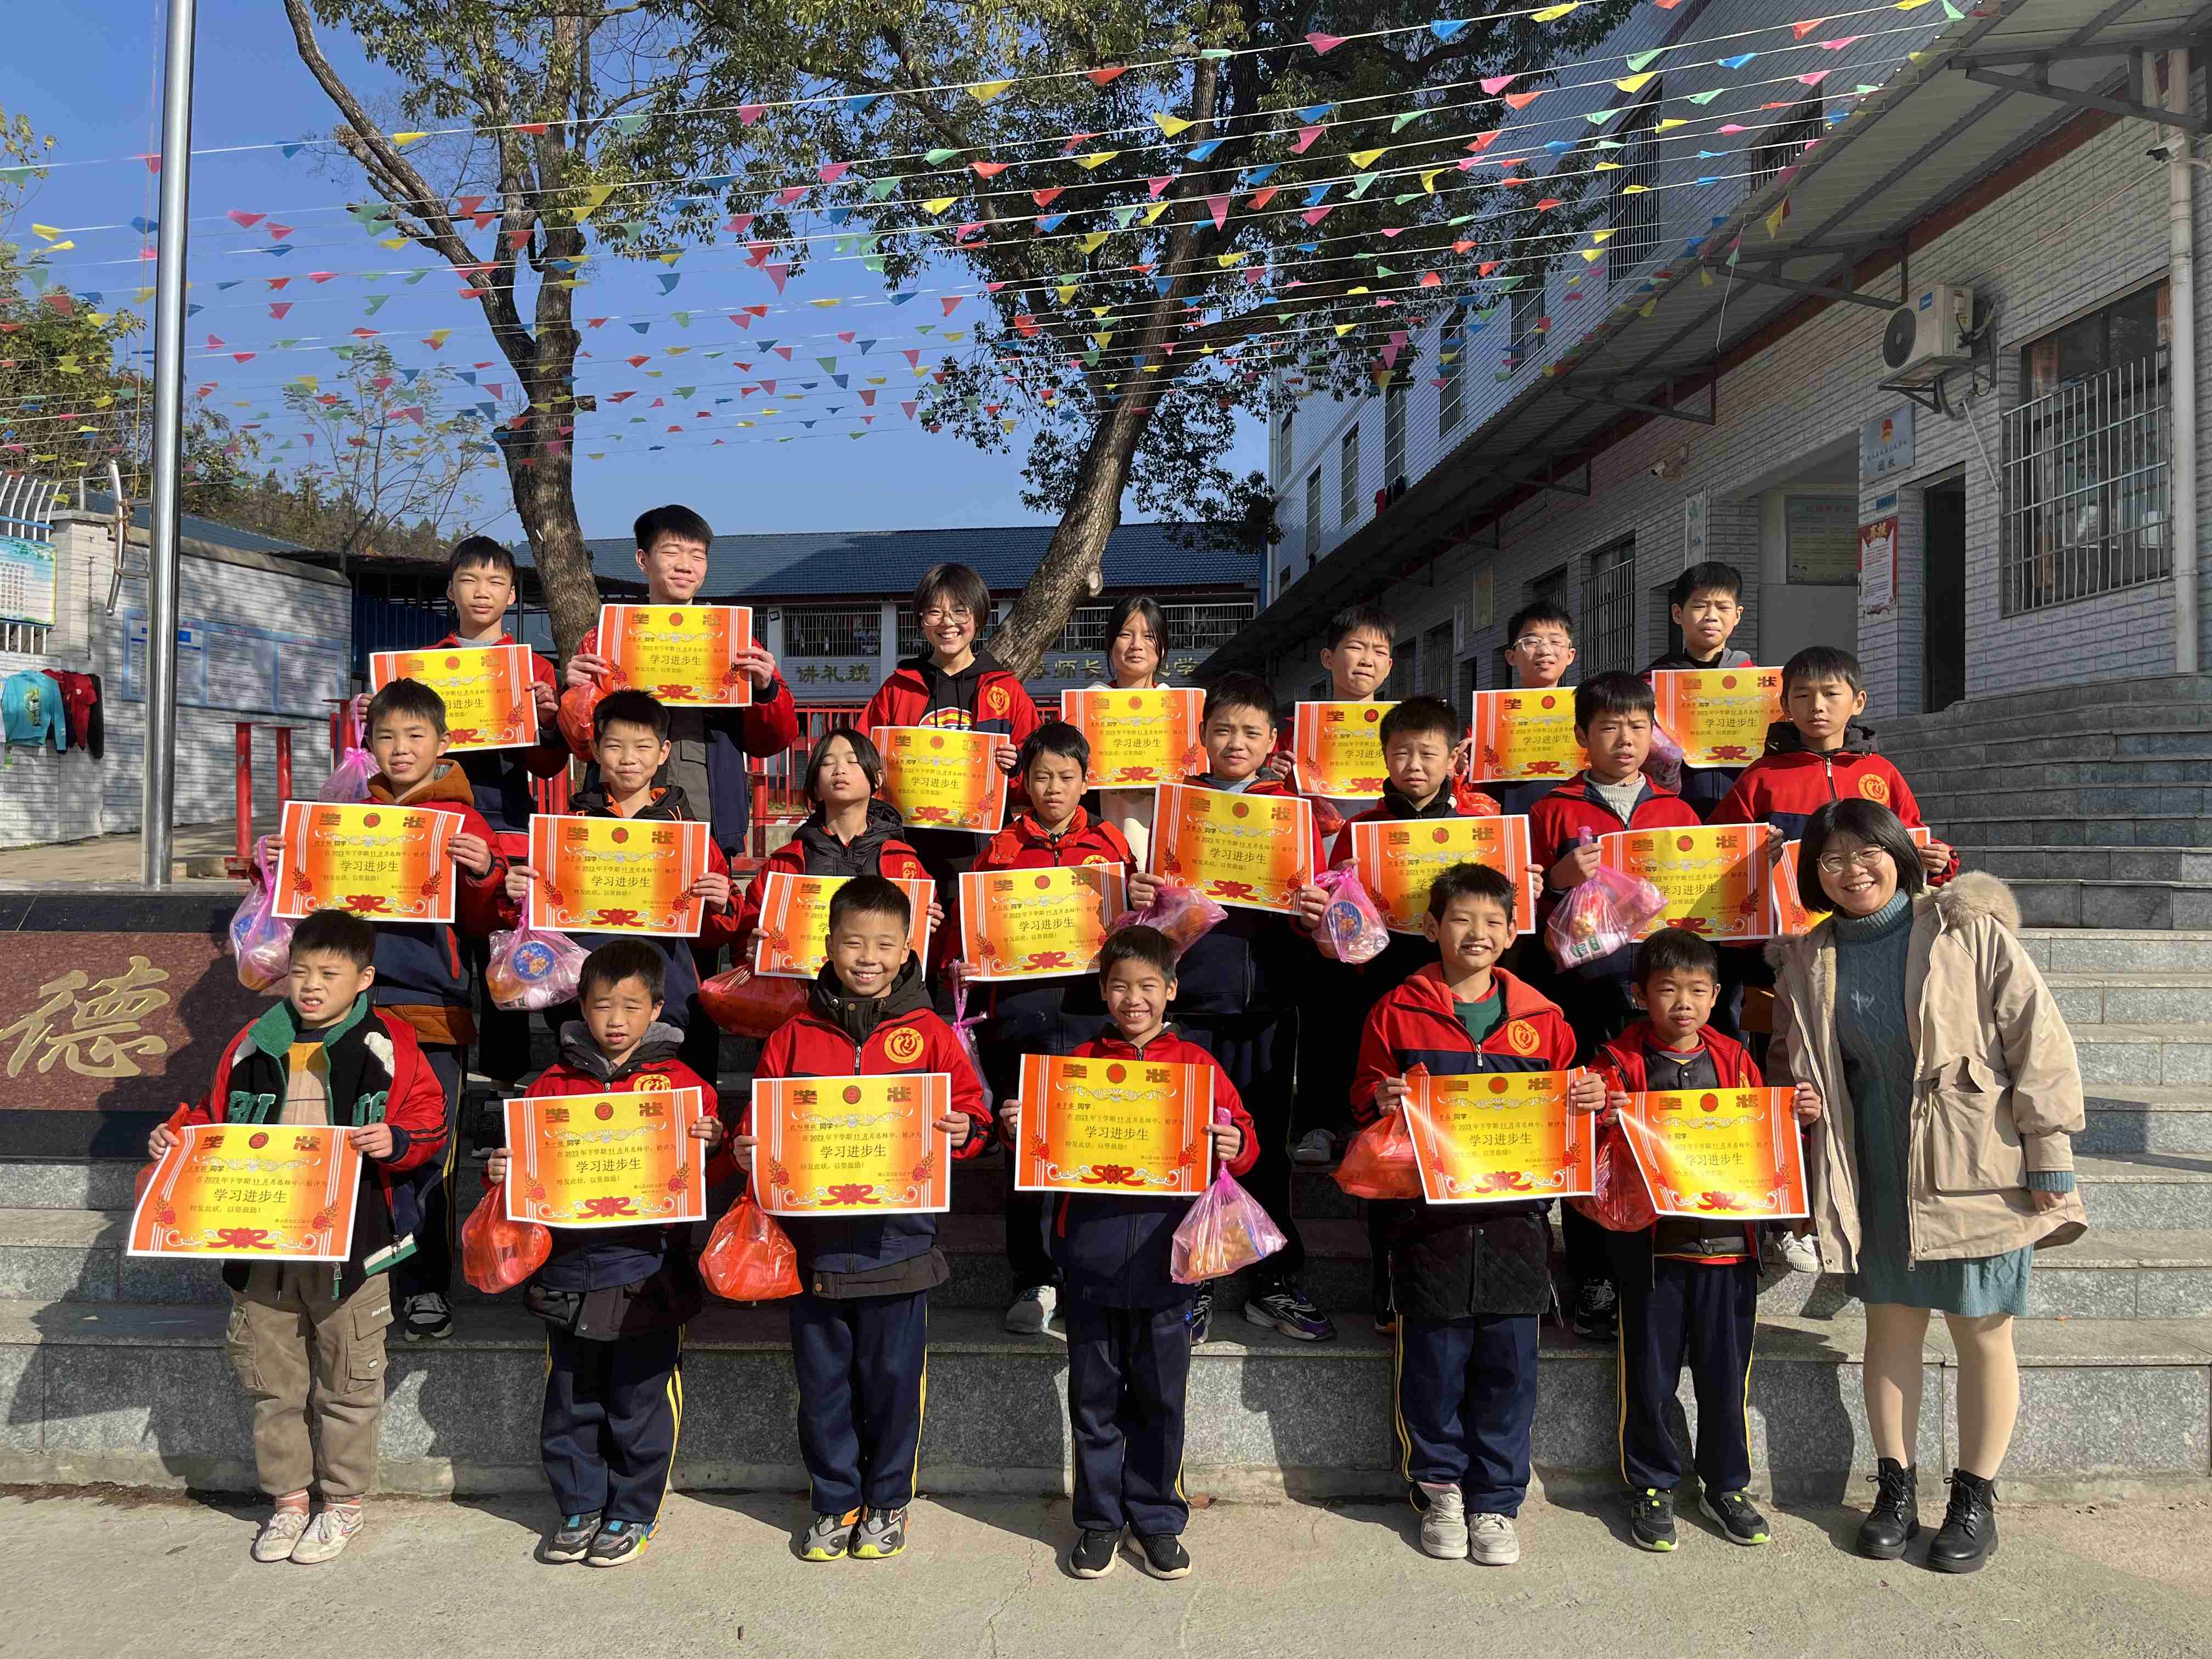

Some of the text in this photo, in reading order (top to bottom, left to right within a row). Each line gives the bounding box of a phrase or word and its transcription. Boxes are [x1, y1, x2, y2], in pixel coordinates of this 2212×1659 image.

[650, 654, 701, 665] 学习进步生
[1705, 719, 1757, 727] 学习进步生
[1114, 737, 1161, 747] 学习进步生
[1523, 735, 1571, 745] 学习进步生
[911, 777, 960, 789] 学习进步生
[1210, 848, 1267, 864] 学习进步生
[341, 861, 399, 872] 学习进步生
[591, 876, 650, 887] 学习进步生
[1660, 884, 1717, 895] 学习进步生
[1019, 918, 1075, 931] 学习进步生
[0, 956, 171, 1079] 德
[1085, 1126, 1149, 1141] 学习进步生
[1470, 1132, 1532, 1146] 学习进步生
[821, 1144, 887, 1159] 学习进步生
[577, 1159, 641, 1173] 学习进步生
[1685, 1154, 1743, 1166] 学习进步生
[214, 1189, 287, 1203] 学习进步生
